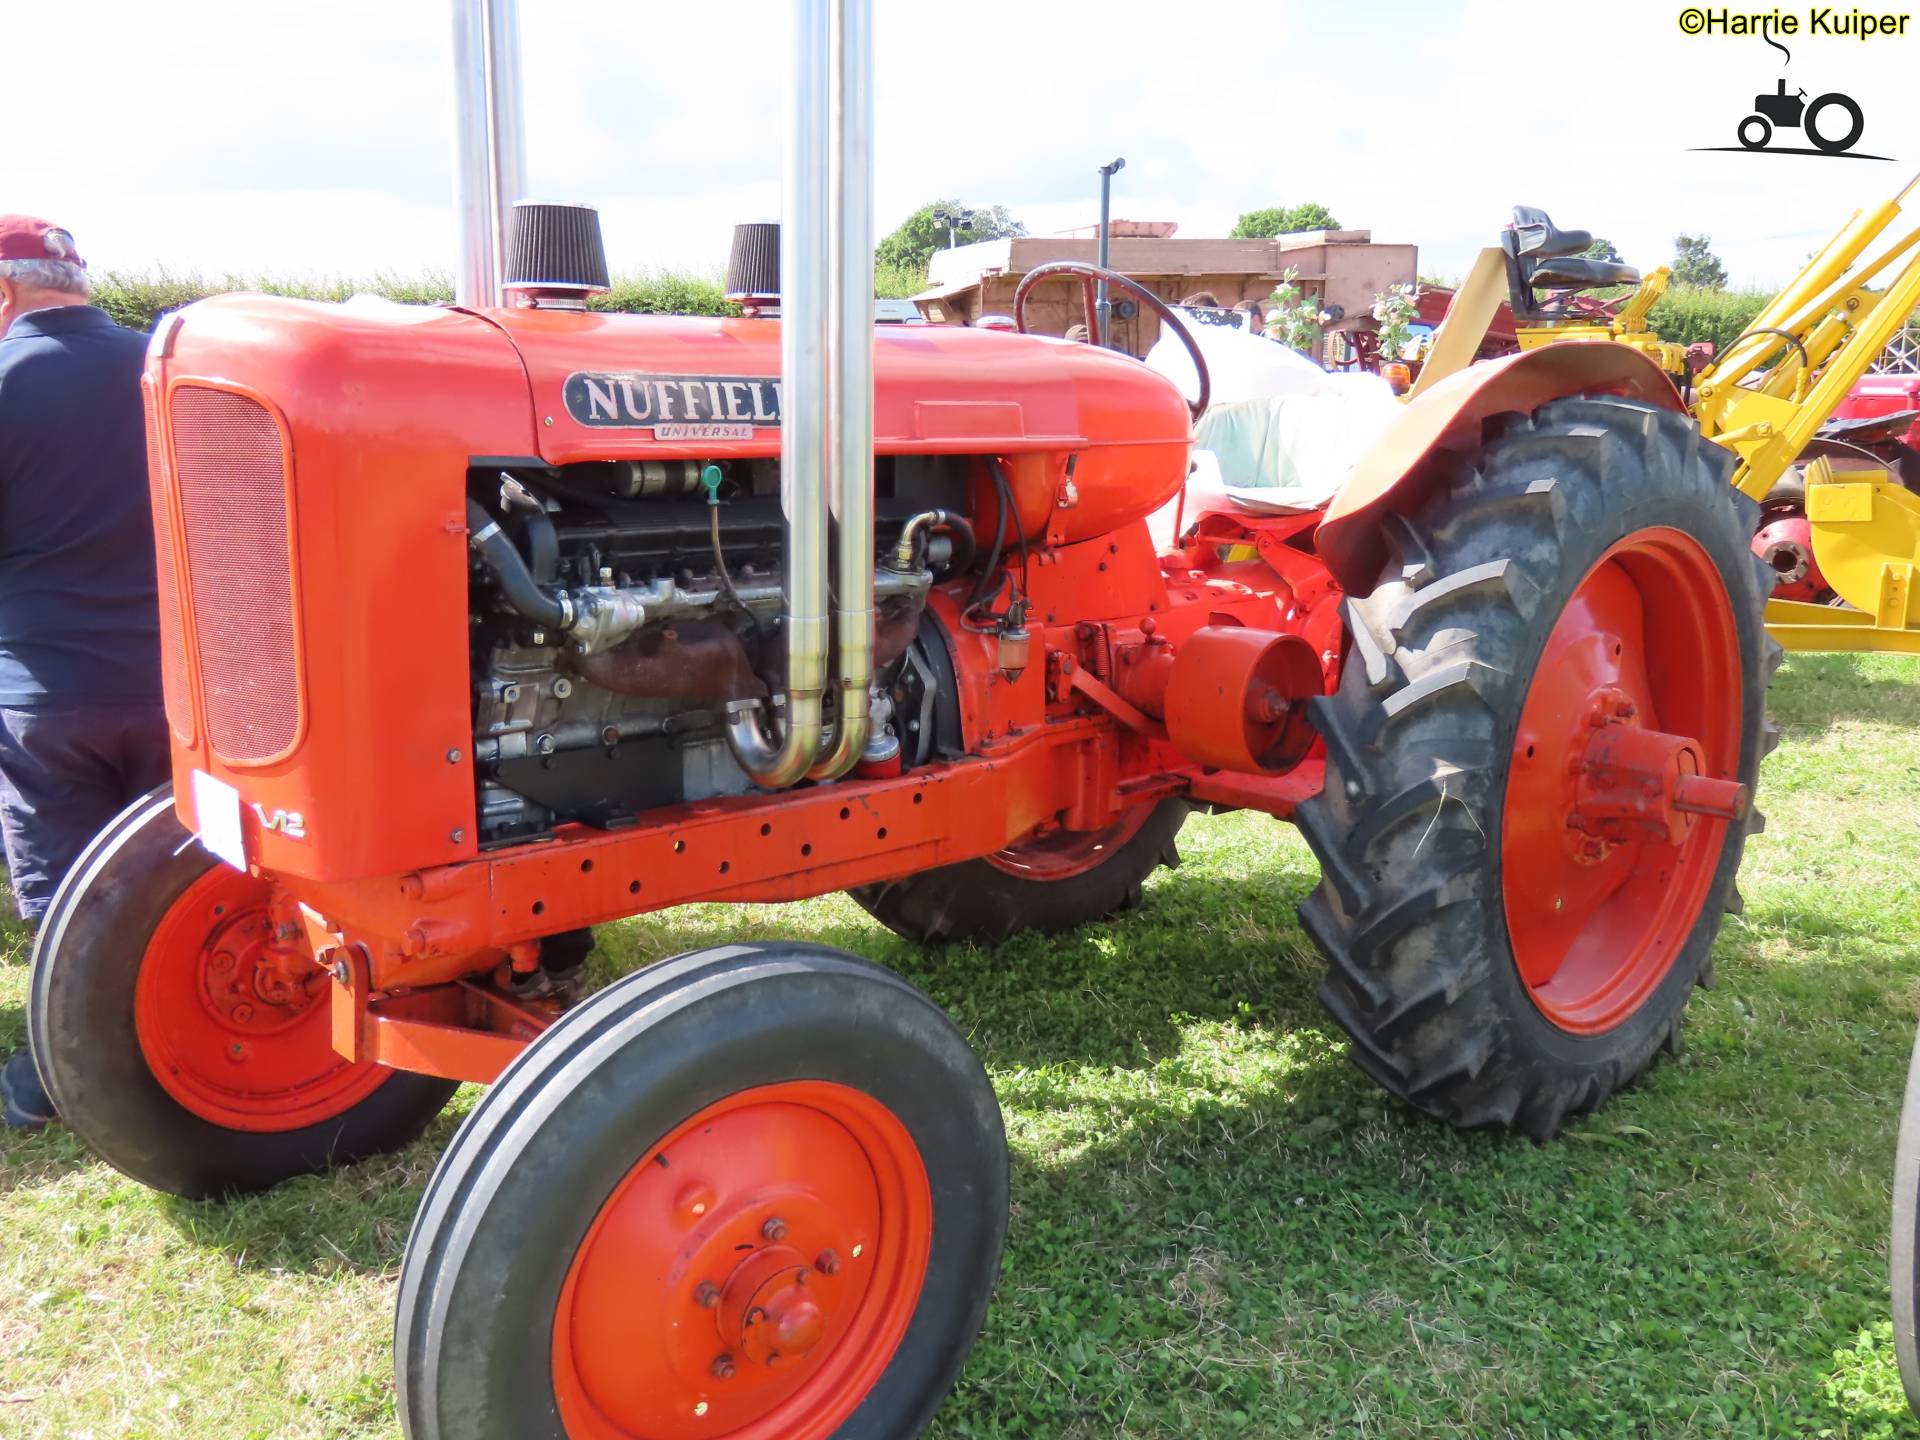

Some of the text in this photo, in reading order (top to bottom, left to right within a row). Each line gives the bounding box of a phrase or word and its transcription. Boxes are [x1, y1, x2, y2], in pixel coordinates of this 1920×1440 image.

[583, 378, 782, 421] NUFFIEL
[660, 425, 750, 438] UNIVERSAL
[251, 802, 306, 838] V12
